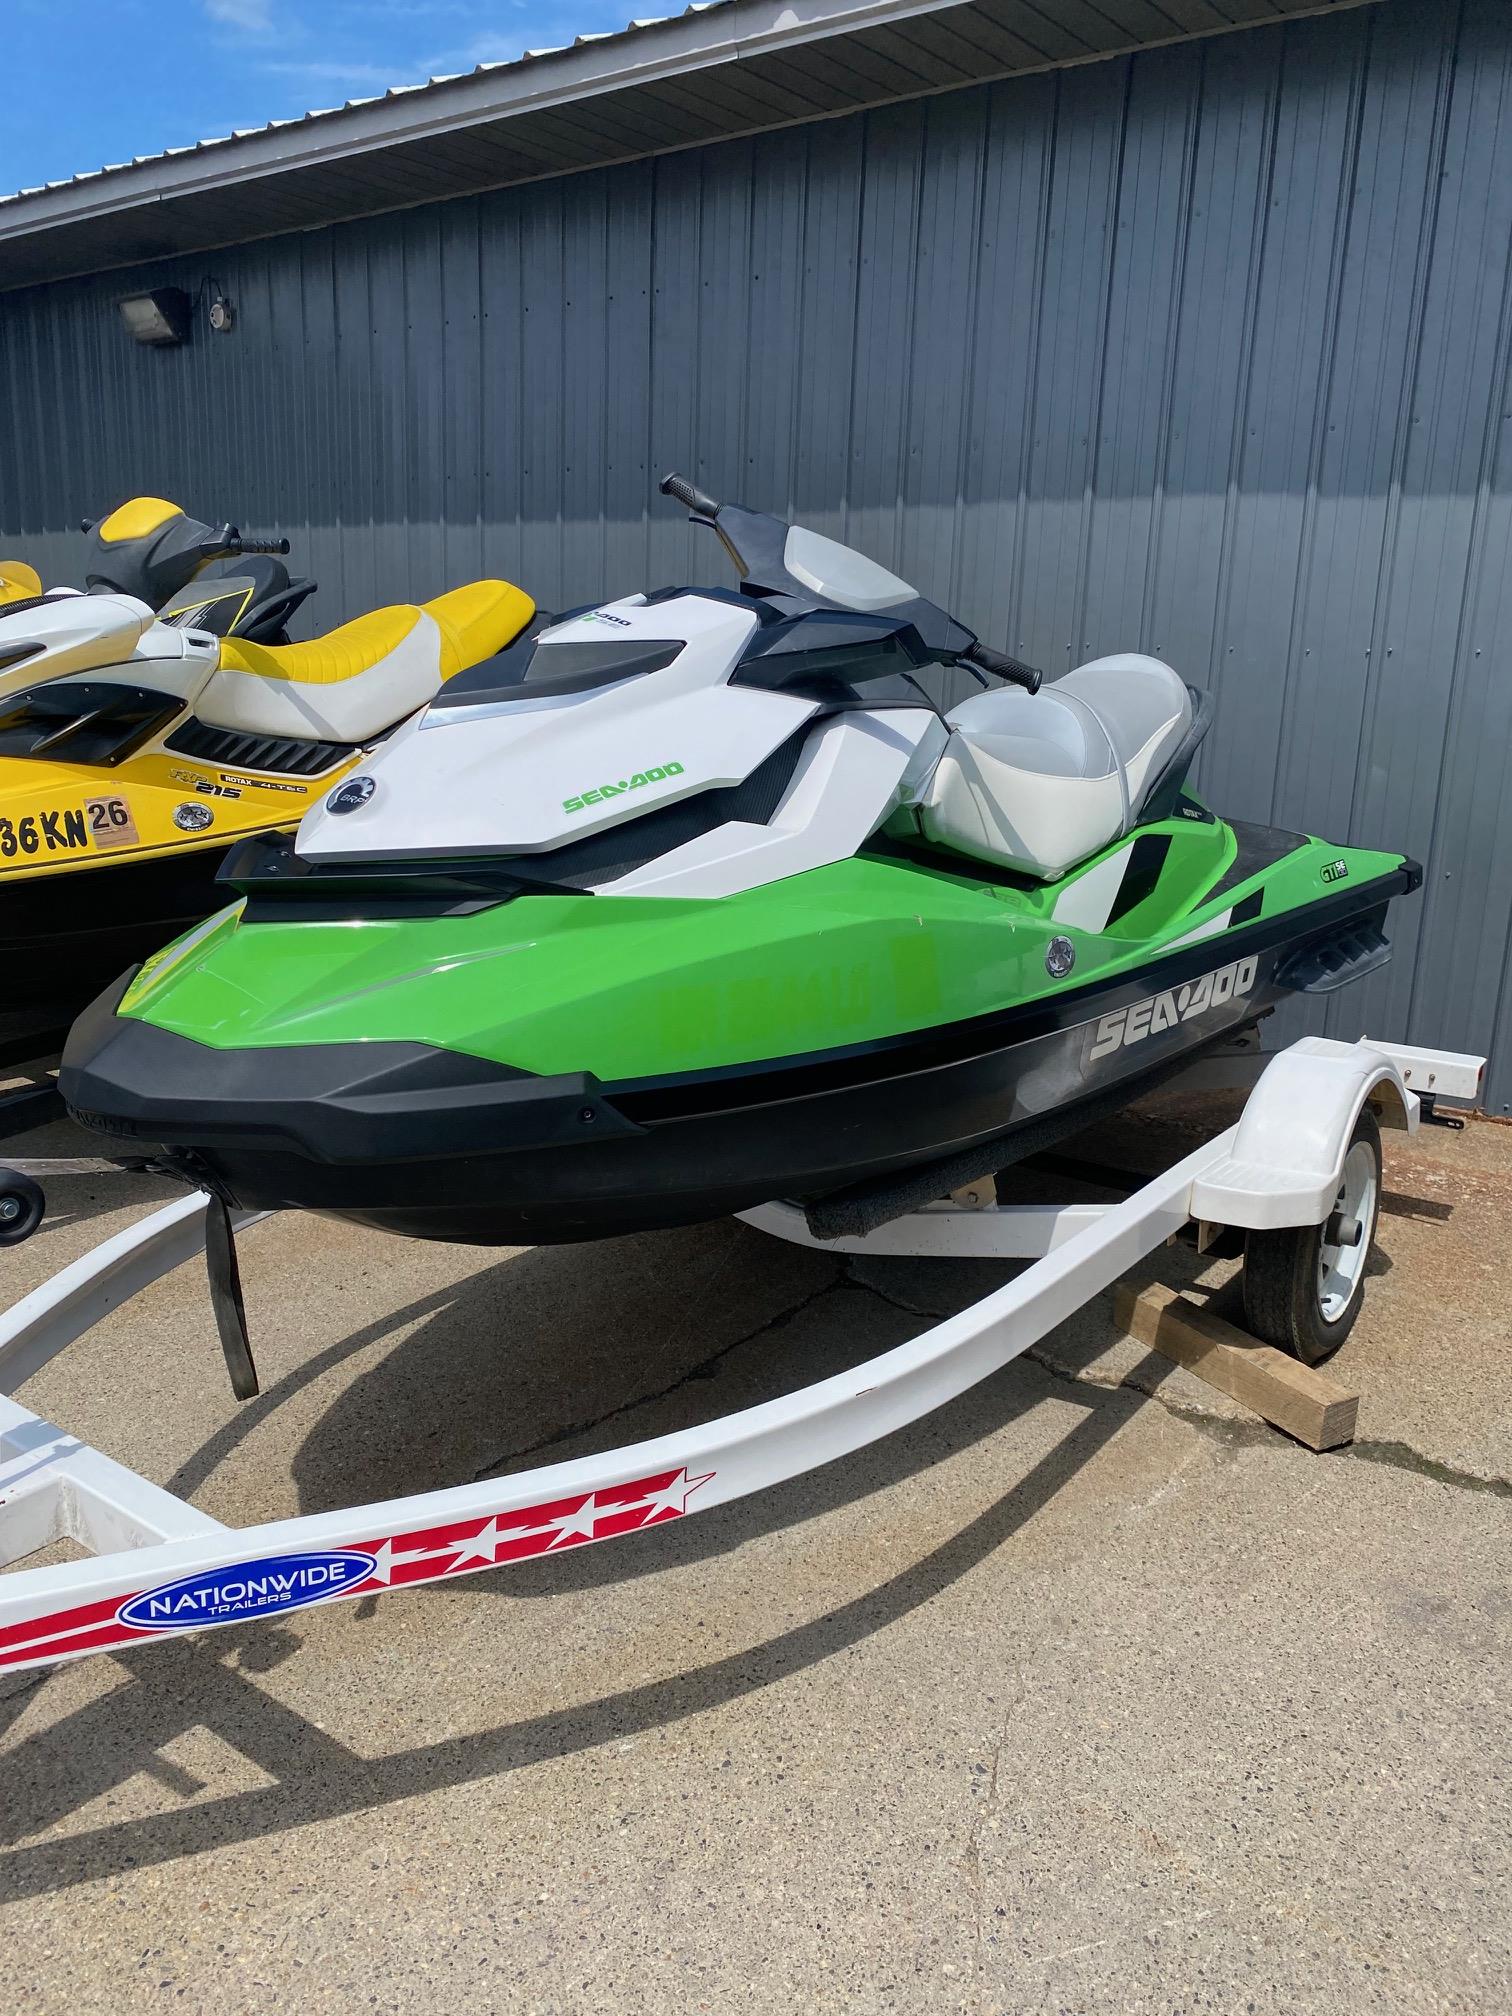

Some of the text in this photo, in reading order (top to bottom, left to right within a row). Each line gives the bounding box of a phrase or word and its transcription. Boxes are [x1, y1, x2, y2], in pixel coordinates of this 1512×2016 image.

[225, 775, 252, 786] ROTAX
[195, 781, 243, 799] 215
[340, 793, 365, 804] BRP
[88, 800, 128, 829] 26
[1335, 860, 1346, 870] SE
[150, 1562, 346, 1618] NATIONWIDE
[208, 1591, 292, 1616] TRAILERS
